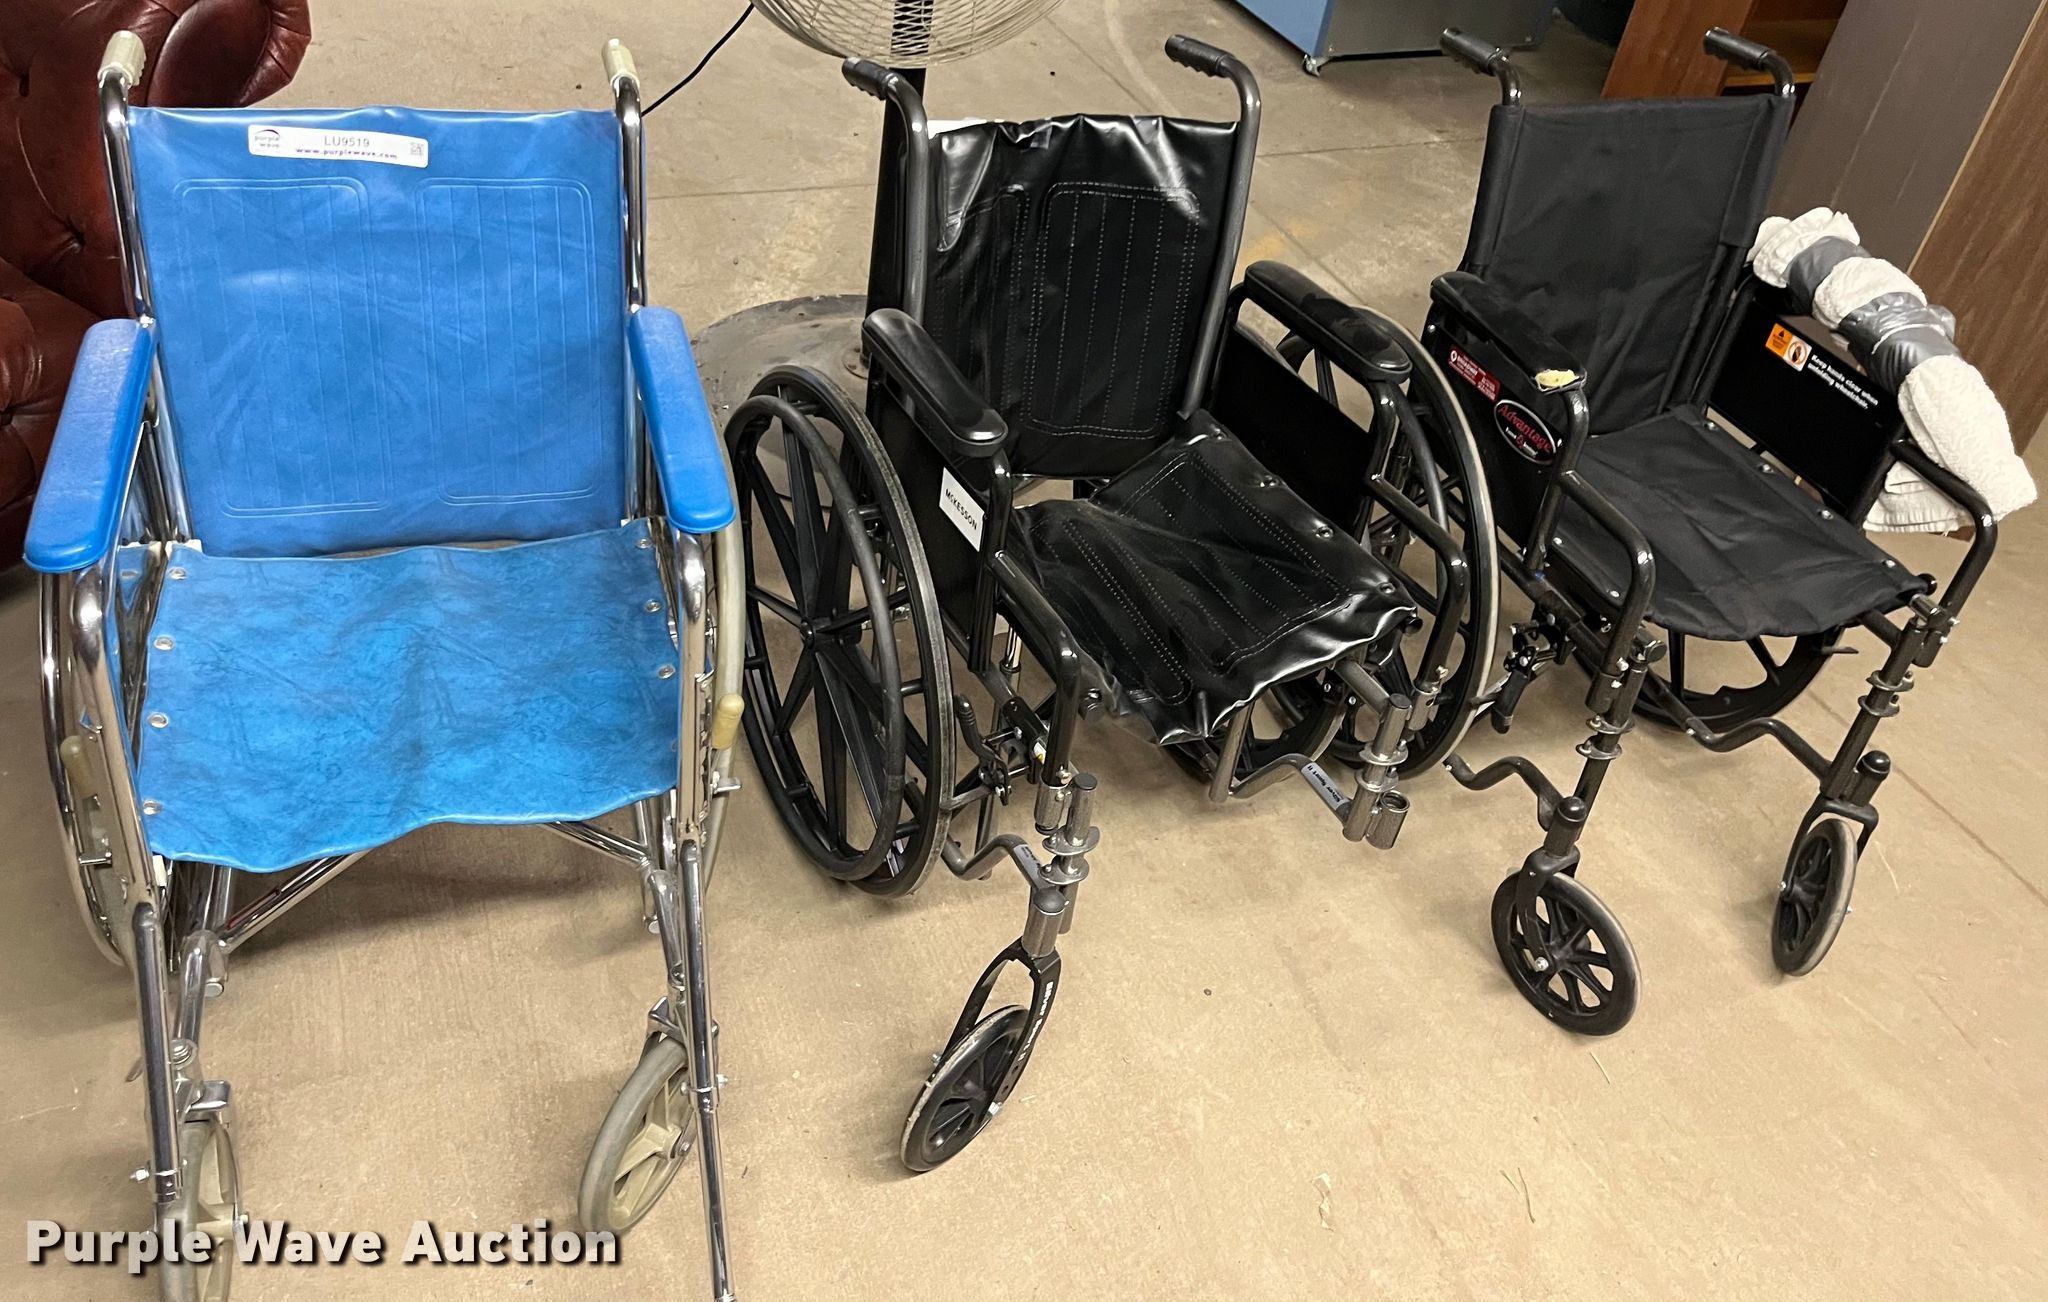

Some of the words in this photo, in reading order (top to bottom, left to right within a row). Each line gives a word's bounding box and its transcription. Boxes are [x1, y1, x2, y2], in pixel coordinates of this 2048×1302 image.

[323, 135, 371, 148] LU9519
[296, 148, 398, 160] www.purplewave.com
[1807, 362, 1835, 386] unfolding
[1811, 354, 1828, 370] Keep
[1827, 364, 1846, 382] hands
[1845, 379, 1862, 393] clear
[1861, 390, 1879, 406] when
[1499, 403, 1552, 453] Advantage
